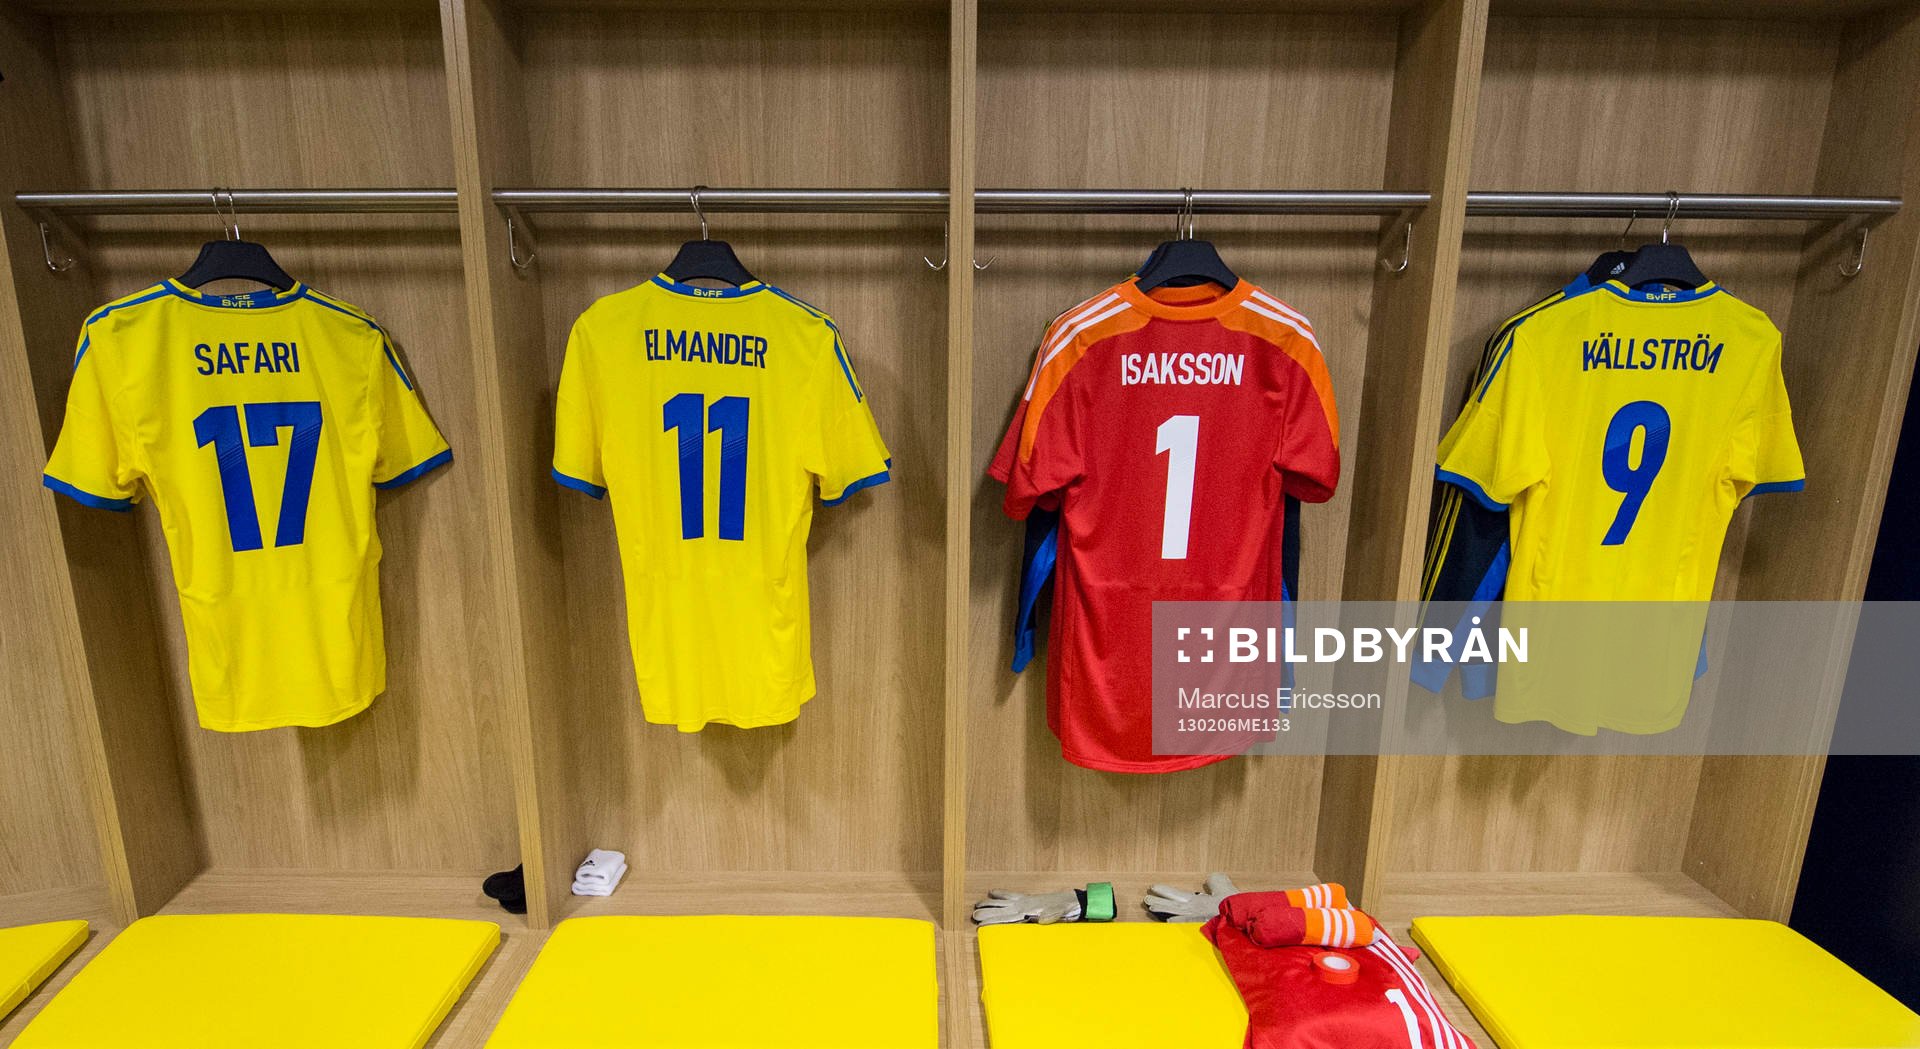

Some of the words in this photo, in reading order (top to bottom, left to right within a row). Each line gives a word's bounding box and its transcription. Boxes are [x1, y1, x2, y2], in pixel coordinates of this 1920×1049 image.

[221, 299, 255, 308] SvFF
[693, 288, 723, 298] SvFF
[1646, 292, 1677, 301] SvFF
[195, 342, 299, 375] SAFARI
[645, 329, 768, 368] ELMANDER
[1121, 352, 1245, 386] ISAKSSON
[193, 401, 323, 552] 17
[663, 393, 750, 541] 11
[1602, 400, 1671, 546] 9
[1155, 414, 1200, 560] 1
[1384, 988, 1424, 1049] 1
